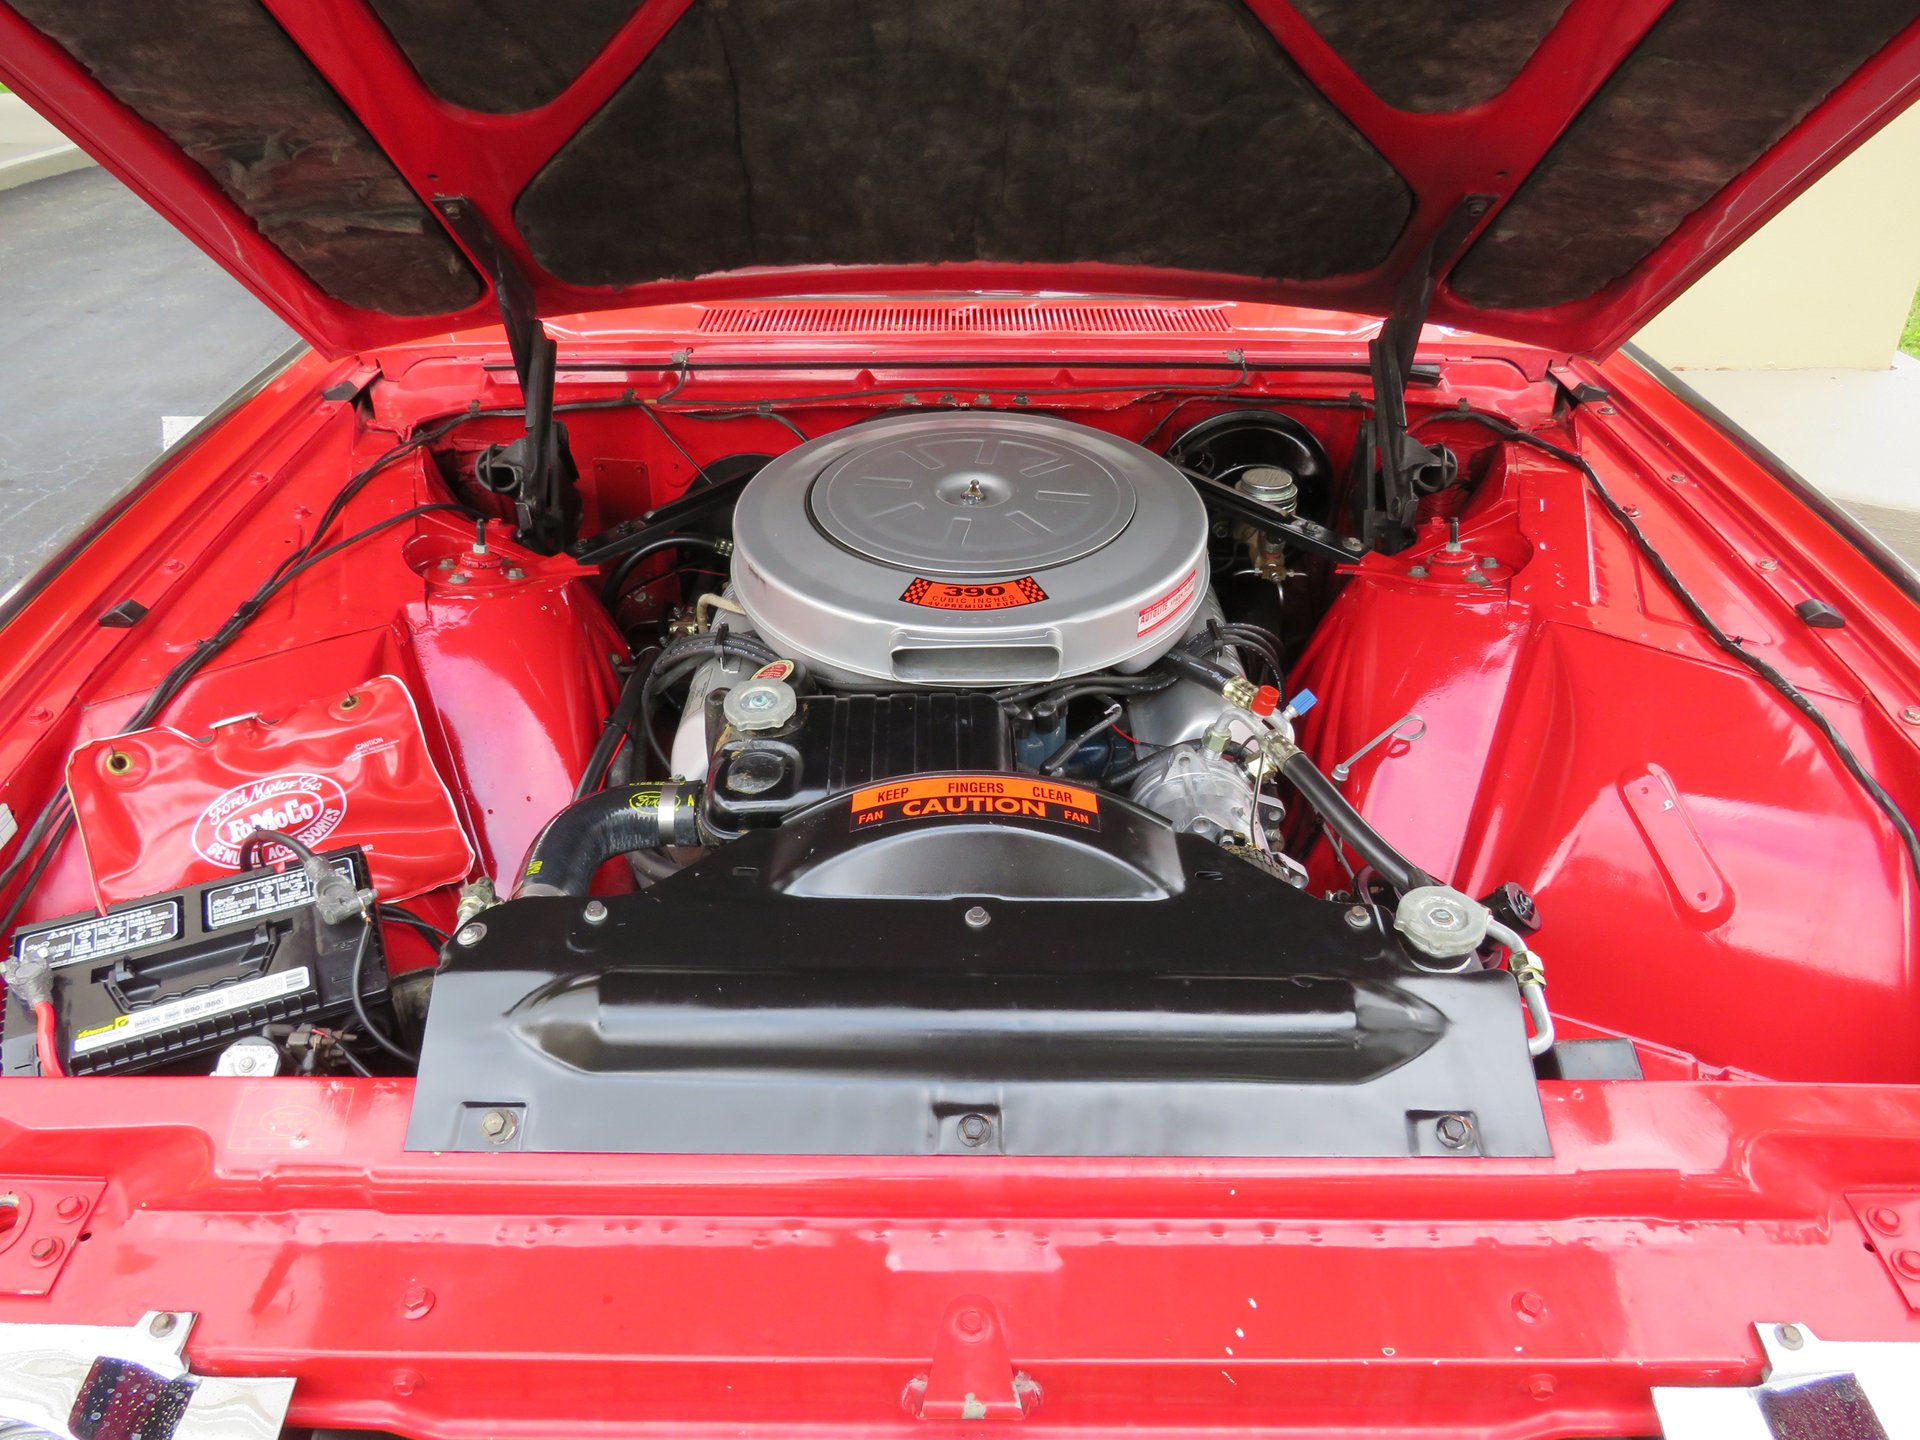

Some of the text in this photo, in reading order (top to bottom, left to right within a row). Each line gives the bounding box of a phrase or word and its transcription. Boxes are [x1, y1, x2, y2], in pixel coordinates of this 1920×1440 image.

[932, 594, 1016, 604] CUBIC INCHES
[943, 586, 1006, 597] 390
[927, 599, 1022, 609] 4V-PREMIUM FUEL
[1140, 602, 1169, 624] AUTOLITE
[355, 736, 384, 750] CAUTION
[208, 788, 250, 826] Ford
[249, 779, 298, 804] Motor
[877, 782, 1073, 804] KEEP FINGERS CLEAR
[227, 799, 314, 843] FoMoCo
[858, 797, 1090, 825] FAN CAUTION FAN
[268, 807, 342, 861] ACCSSORIES
